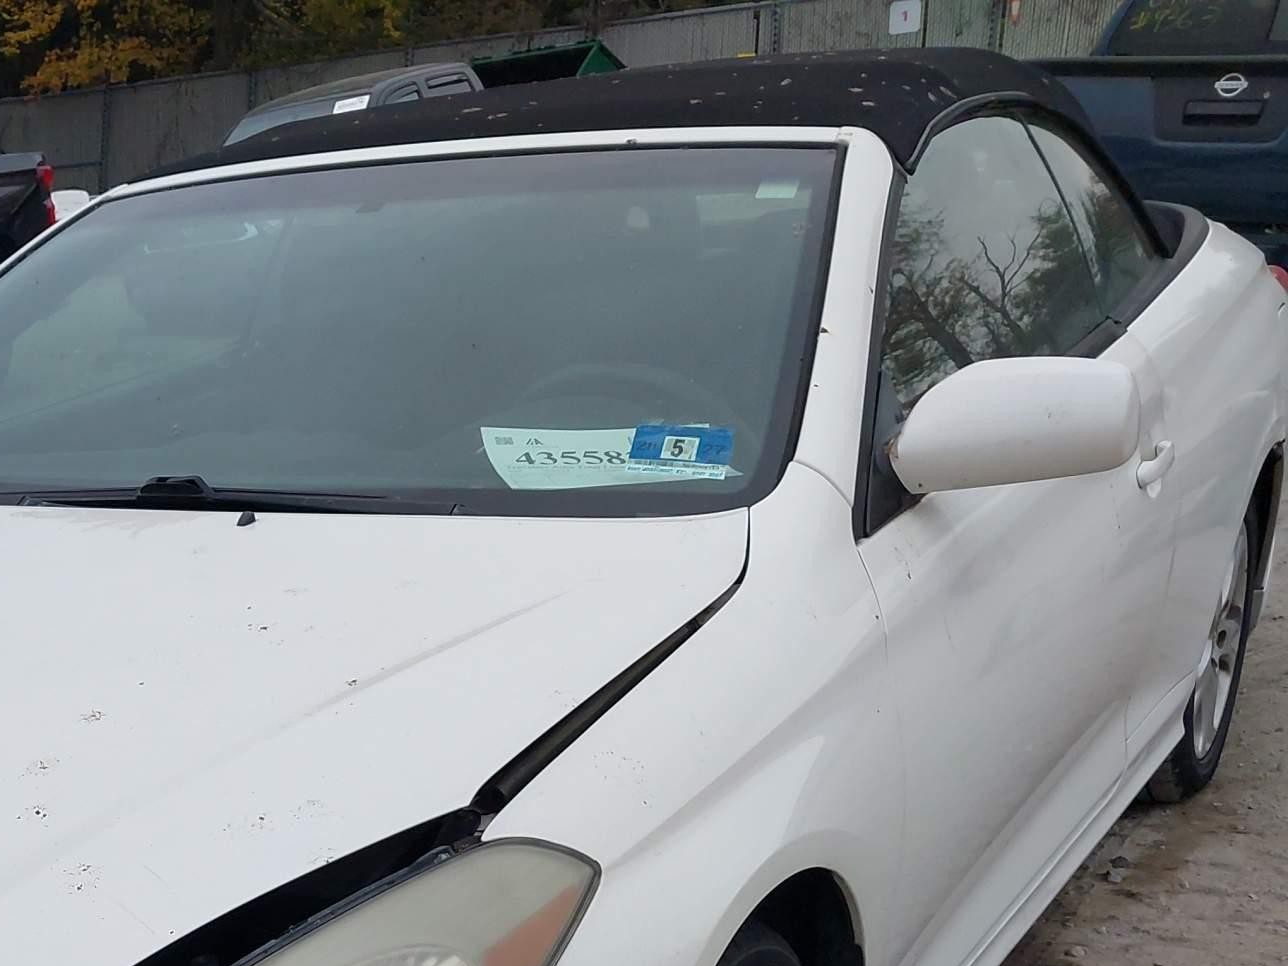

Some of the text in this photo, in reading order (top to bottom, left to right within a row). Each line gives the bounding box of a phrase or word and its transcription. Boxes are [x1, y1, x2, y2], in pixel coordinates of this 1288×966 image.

[901, 10, 908, 22] 1
[670, 439, 685, 458] 5
[515, 450, 630, 465] 43558
